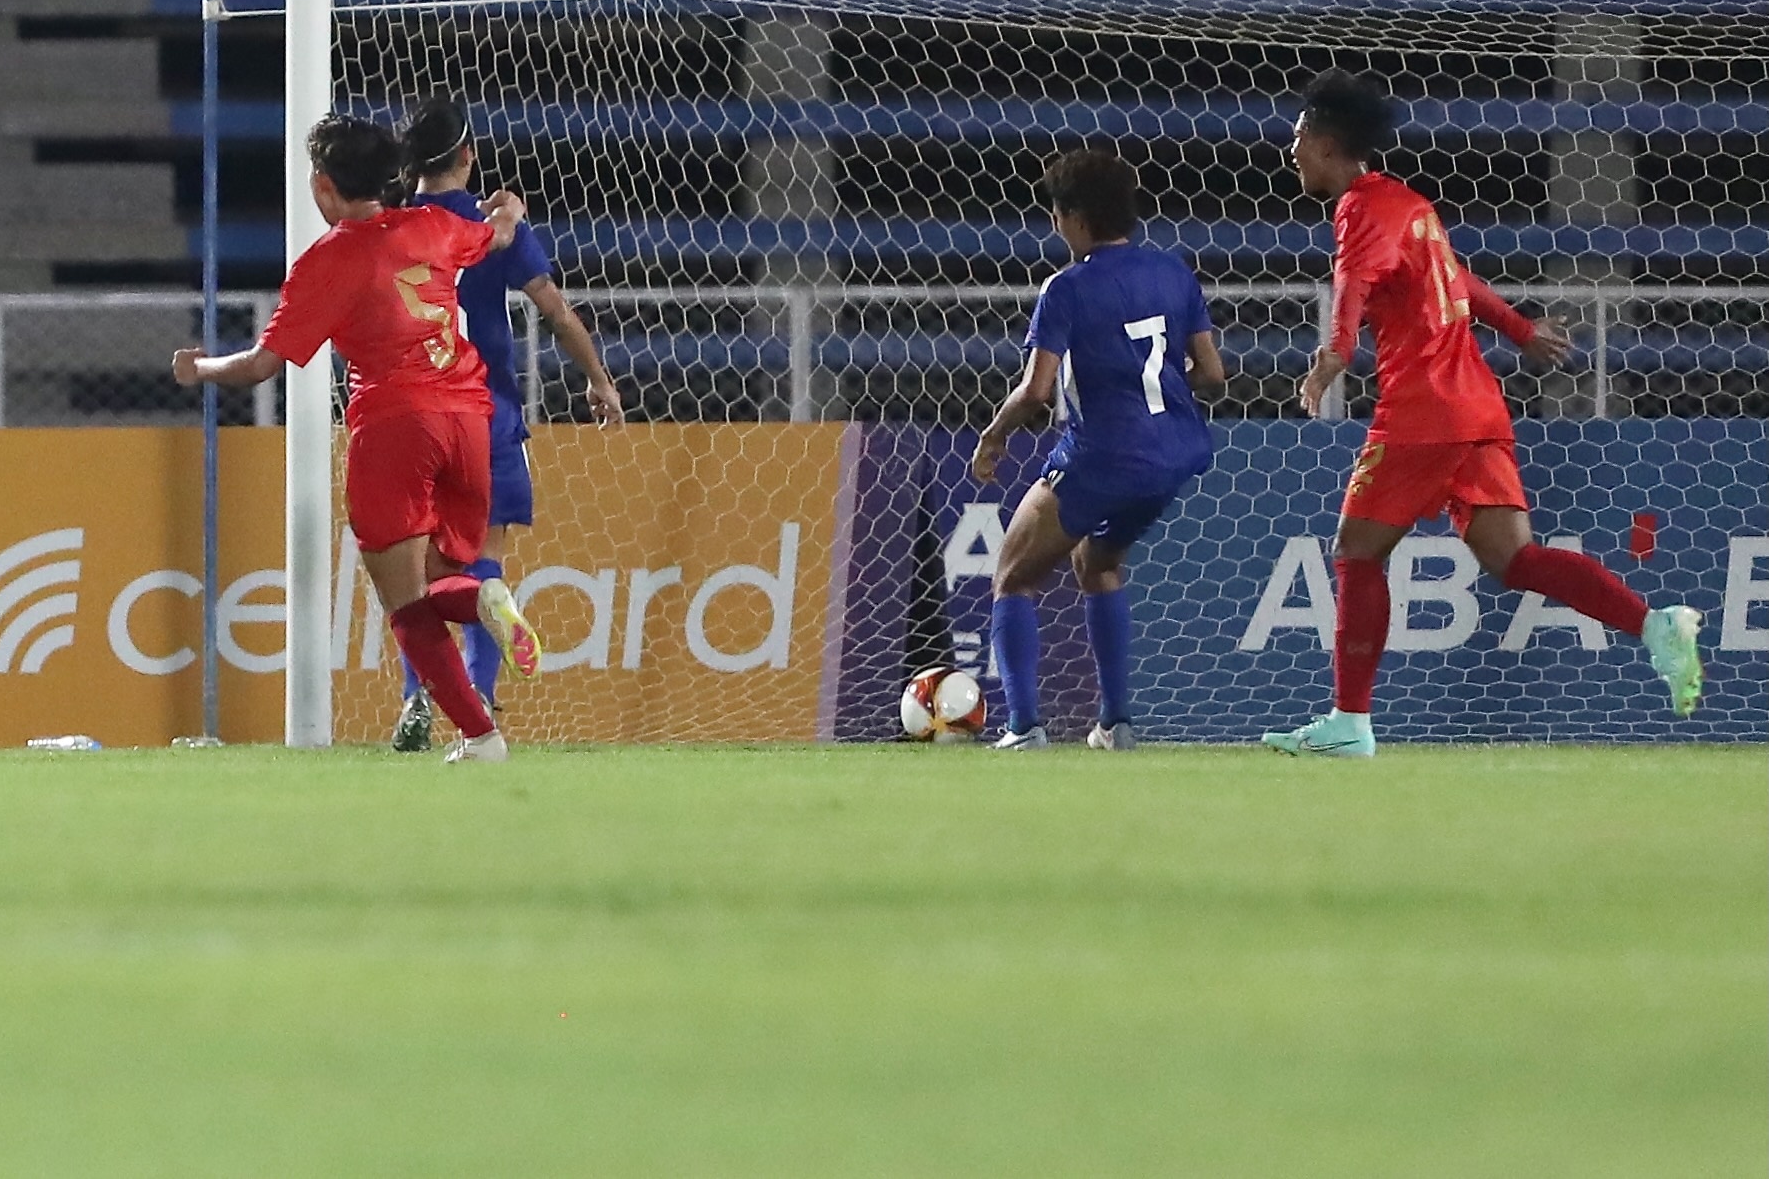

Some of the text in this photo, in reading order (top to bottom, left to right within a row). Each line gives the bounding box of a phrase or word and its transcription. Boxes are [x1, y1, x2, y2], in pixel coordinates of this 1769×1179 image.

[393, 262, 460, 370] 5
[1123, 315, 1167, 415] 7
[107, 521, 800, 676] cellard
